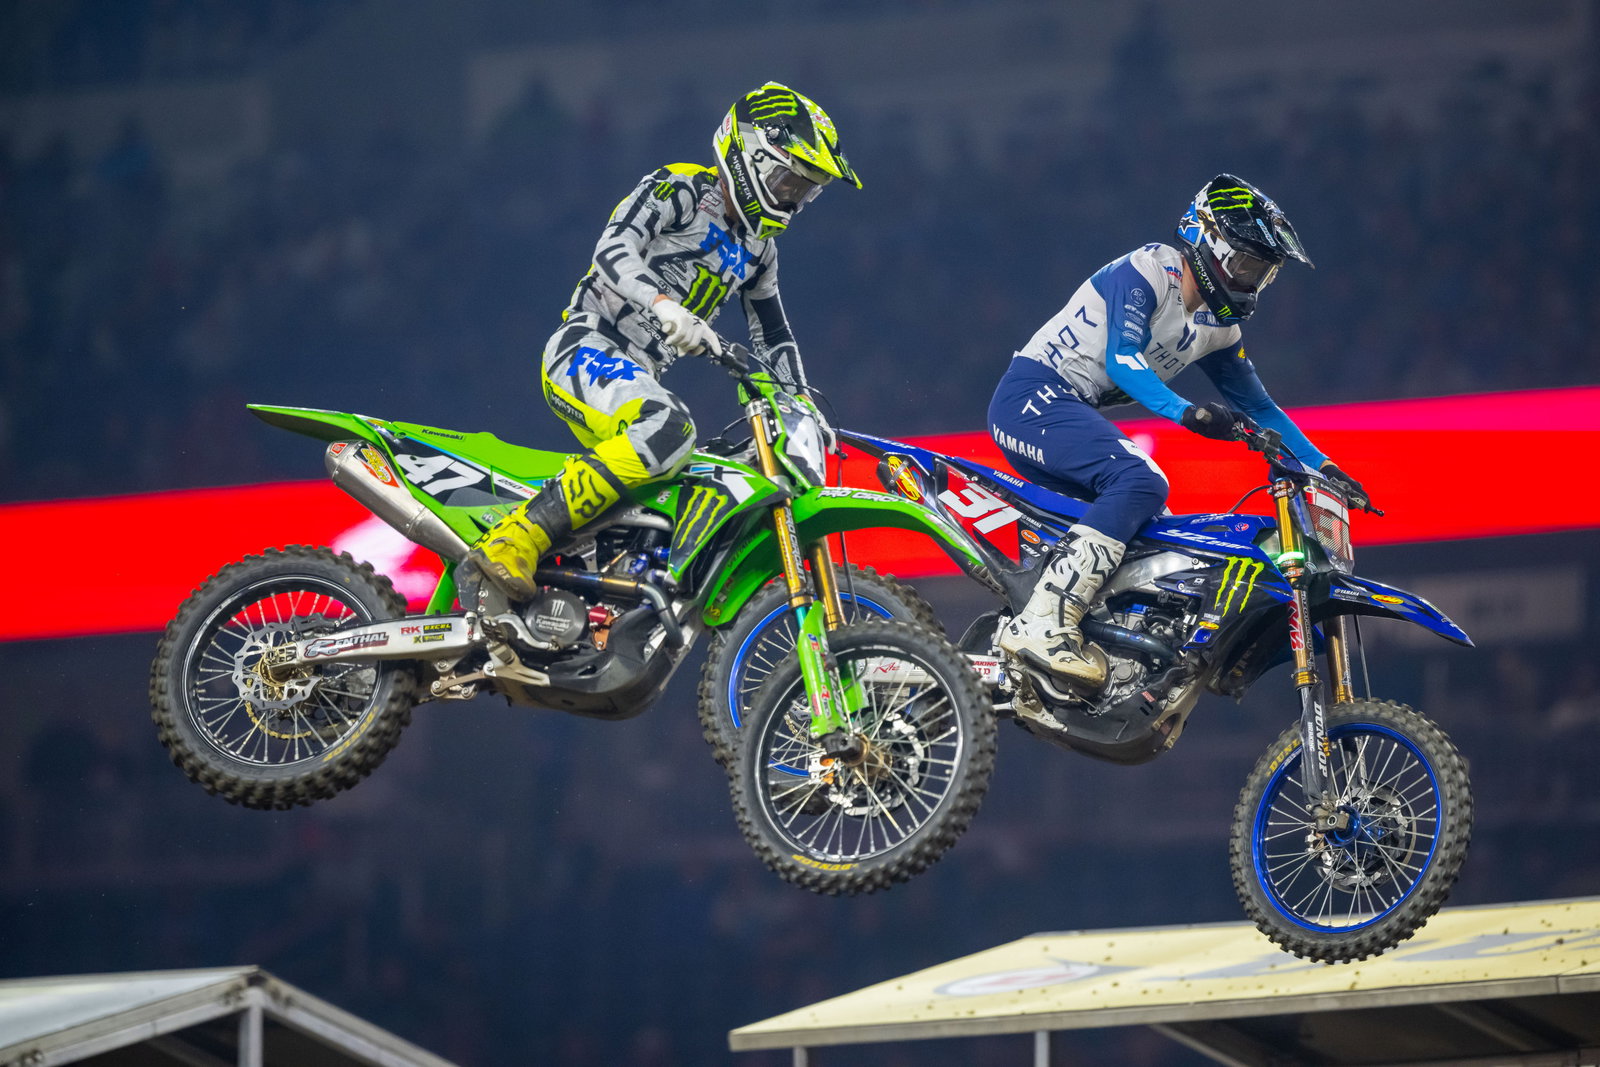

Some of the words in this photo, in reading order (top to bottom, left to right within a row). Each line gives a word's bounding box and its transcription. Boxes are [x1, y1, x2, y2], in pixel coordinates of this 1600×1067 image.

[732, 155, 753, 200] MONSTER
[1043, 305, 1098, 369] HOR
[421, 428, 464, 440] Kawasaki
[992, 423, 1046, 465] YAMAHA
[395, 453, 486, 496] 47
[992, 470, 1024, 488] YAMAHA
[817, 489, 852, 500] PRO
[938, 482, 1023, 534] 31
[783, 506, 796, 534] PRO
[495, 564, 511, 581] FOX
[789, 533, 807, 584] CIRCUIT
[401, 626, 421, 635] RK
[424, 623, 451, 631] EXCEL
[304, 631, 390, 658] RENTHAL
[1313, 701, 1328, 778] DUNLOP
[792, 854, 853, 871] DUNLOP
